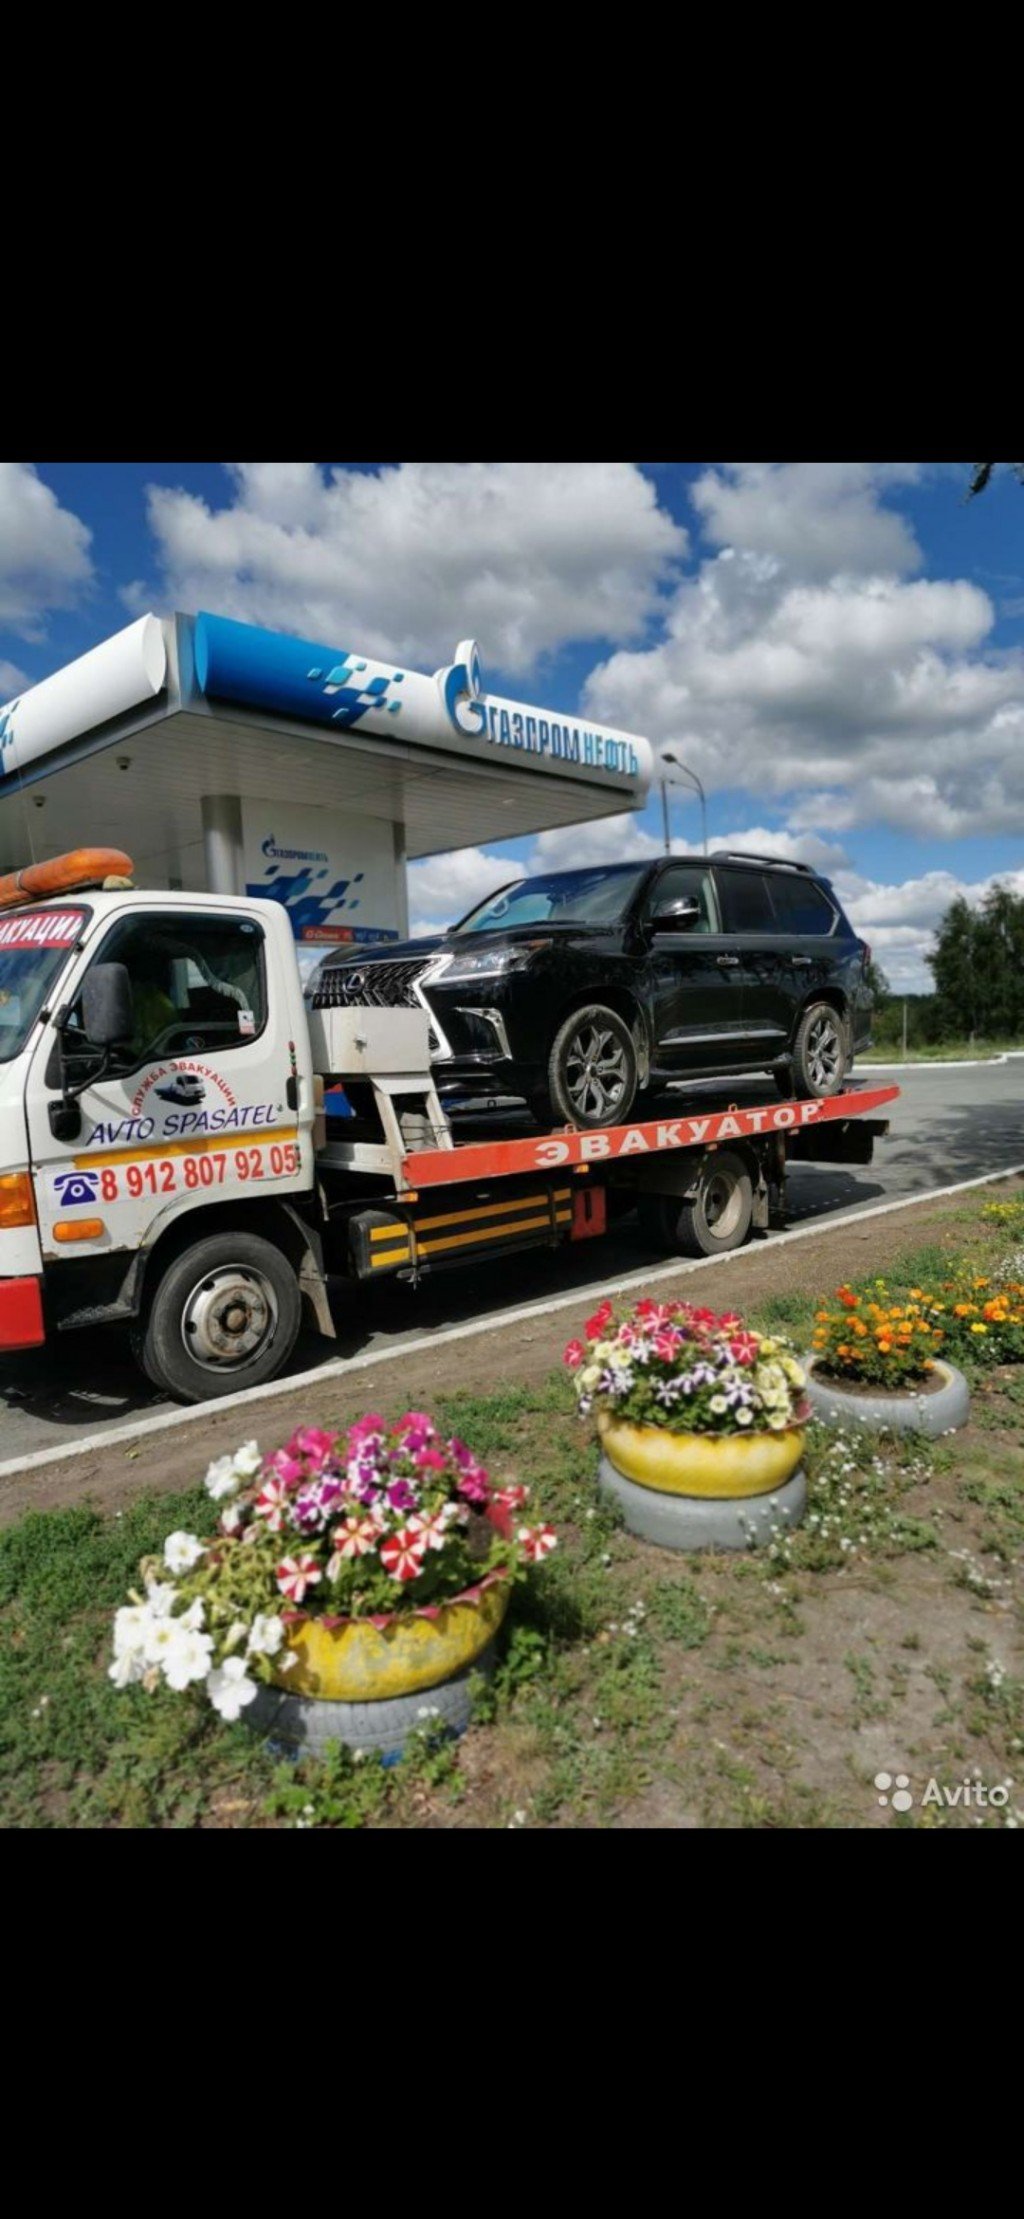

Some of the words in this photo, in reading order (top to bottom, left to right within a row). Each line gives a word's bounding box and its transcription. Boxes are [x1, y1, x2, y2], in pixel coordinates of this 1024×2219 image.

[131, 1067, 167, 1117] СЛУЖБА
[169, 1060, 237, 1108] ЭВАКУАЦИИ
[85, 1117, 155, 1147] AVTO
[163, 1103, 277, 1136] SPASATEL
[534, 1102, 821, 1167] ЭВАКУАТОР
[100, 1169, 118, 1201] 8
[126, 1161, 176, 1198] 912
[183, 1153, 227, 1189] 807
[234, 1149, 264, 1181] 92
[269, 1144, 297, 1175] 05
